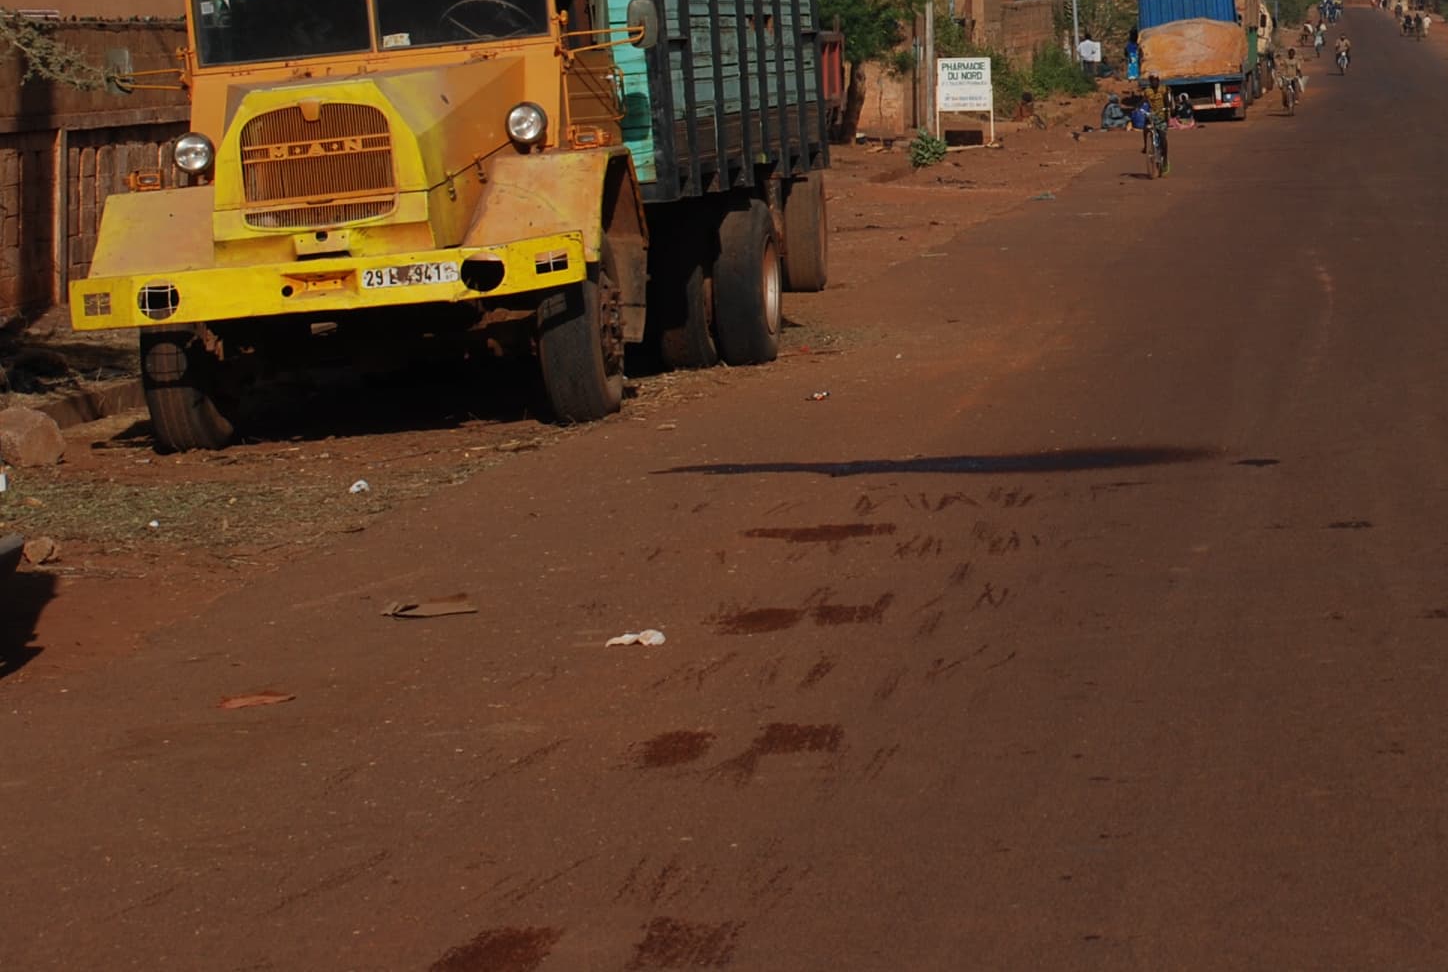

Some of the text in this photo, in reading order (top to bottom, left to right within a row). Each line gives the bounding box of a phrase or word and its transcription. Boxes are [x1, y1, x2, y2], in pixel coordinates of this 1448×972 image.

[948, 72, 983, 81] DU NORD
[365, 269, 384, 287] 29
